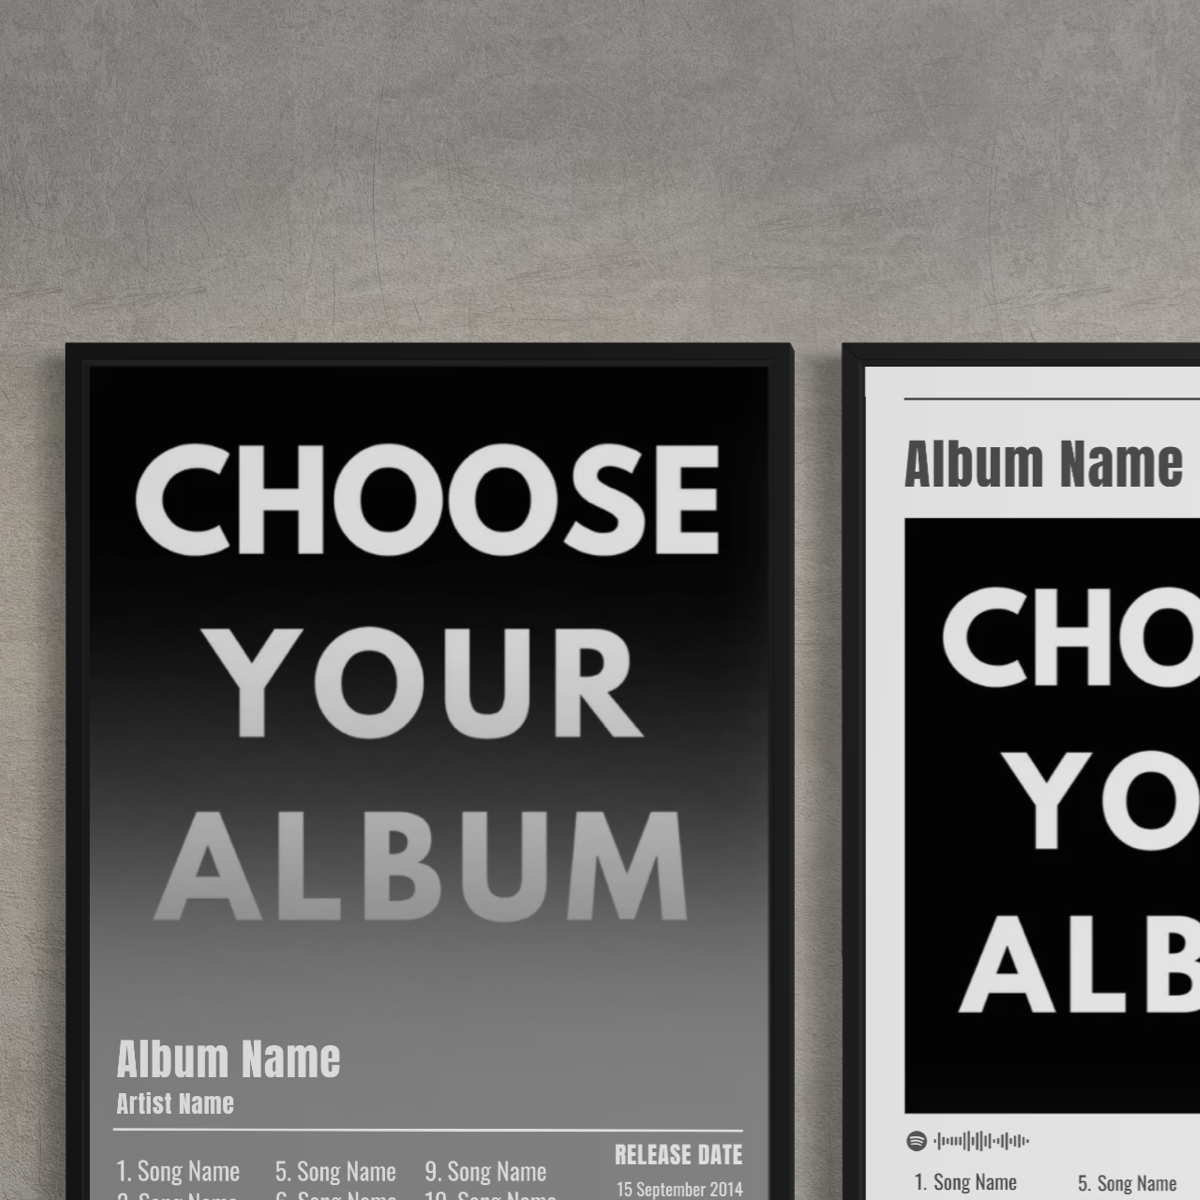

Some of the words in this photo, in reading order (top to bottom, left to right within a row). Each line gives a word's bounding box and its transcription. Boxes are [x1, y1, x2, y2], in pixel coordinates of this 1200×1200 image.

[904, 439, 1043, 488] Album
[1061, 440, 1183, 488] Name
[135, 443, 719, 556] CHOOSE
[200, 626, 644, 740] YOUR
[154, 811, 687, 922] ALBUM
[116, 1039, 229, 1078] Album
[242, 1039, 340, 1078] Name
[116, 1091, 172, 1115] Artist
[179, 1092, 234, 1115] Name
[615, 1143, 692, 1166] RELEASE
[698, 1143, 743, 1165] DATE
[116, 1159, 132, 1182] 1.
[137, 1159, 183, 1186] Song
[189, 1159, 240, 1182] Name
[275, 1160, 292, 1182] 5.
[297, 1160, 342, 1186] Song
[347, 1160, 396, 1182] Name
[425, 1160, 442, 1182] 9.
[447, 1160, 492, 1186] Song
[497, 1160, 547, 1182] Name
[915, 1173, 927, 1191] 1.
[934, 1172, 971, 1194] Song
[975, 1173, 1017, 1191] Name
[1078, 1174, 1092, 1192] 5.
[1097, 1174, 1133, 1195] Song
[1137, 1174, 1177, 1192] Name
[617, 1181, 633, 1197] 15
[636, 1181, 707, 1200] September
[709, 1181, 744, 1197] 2014
